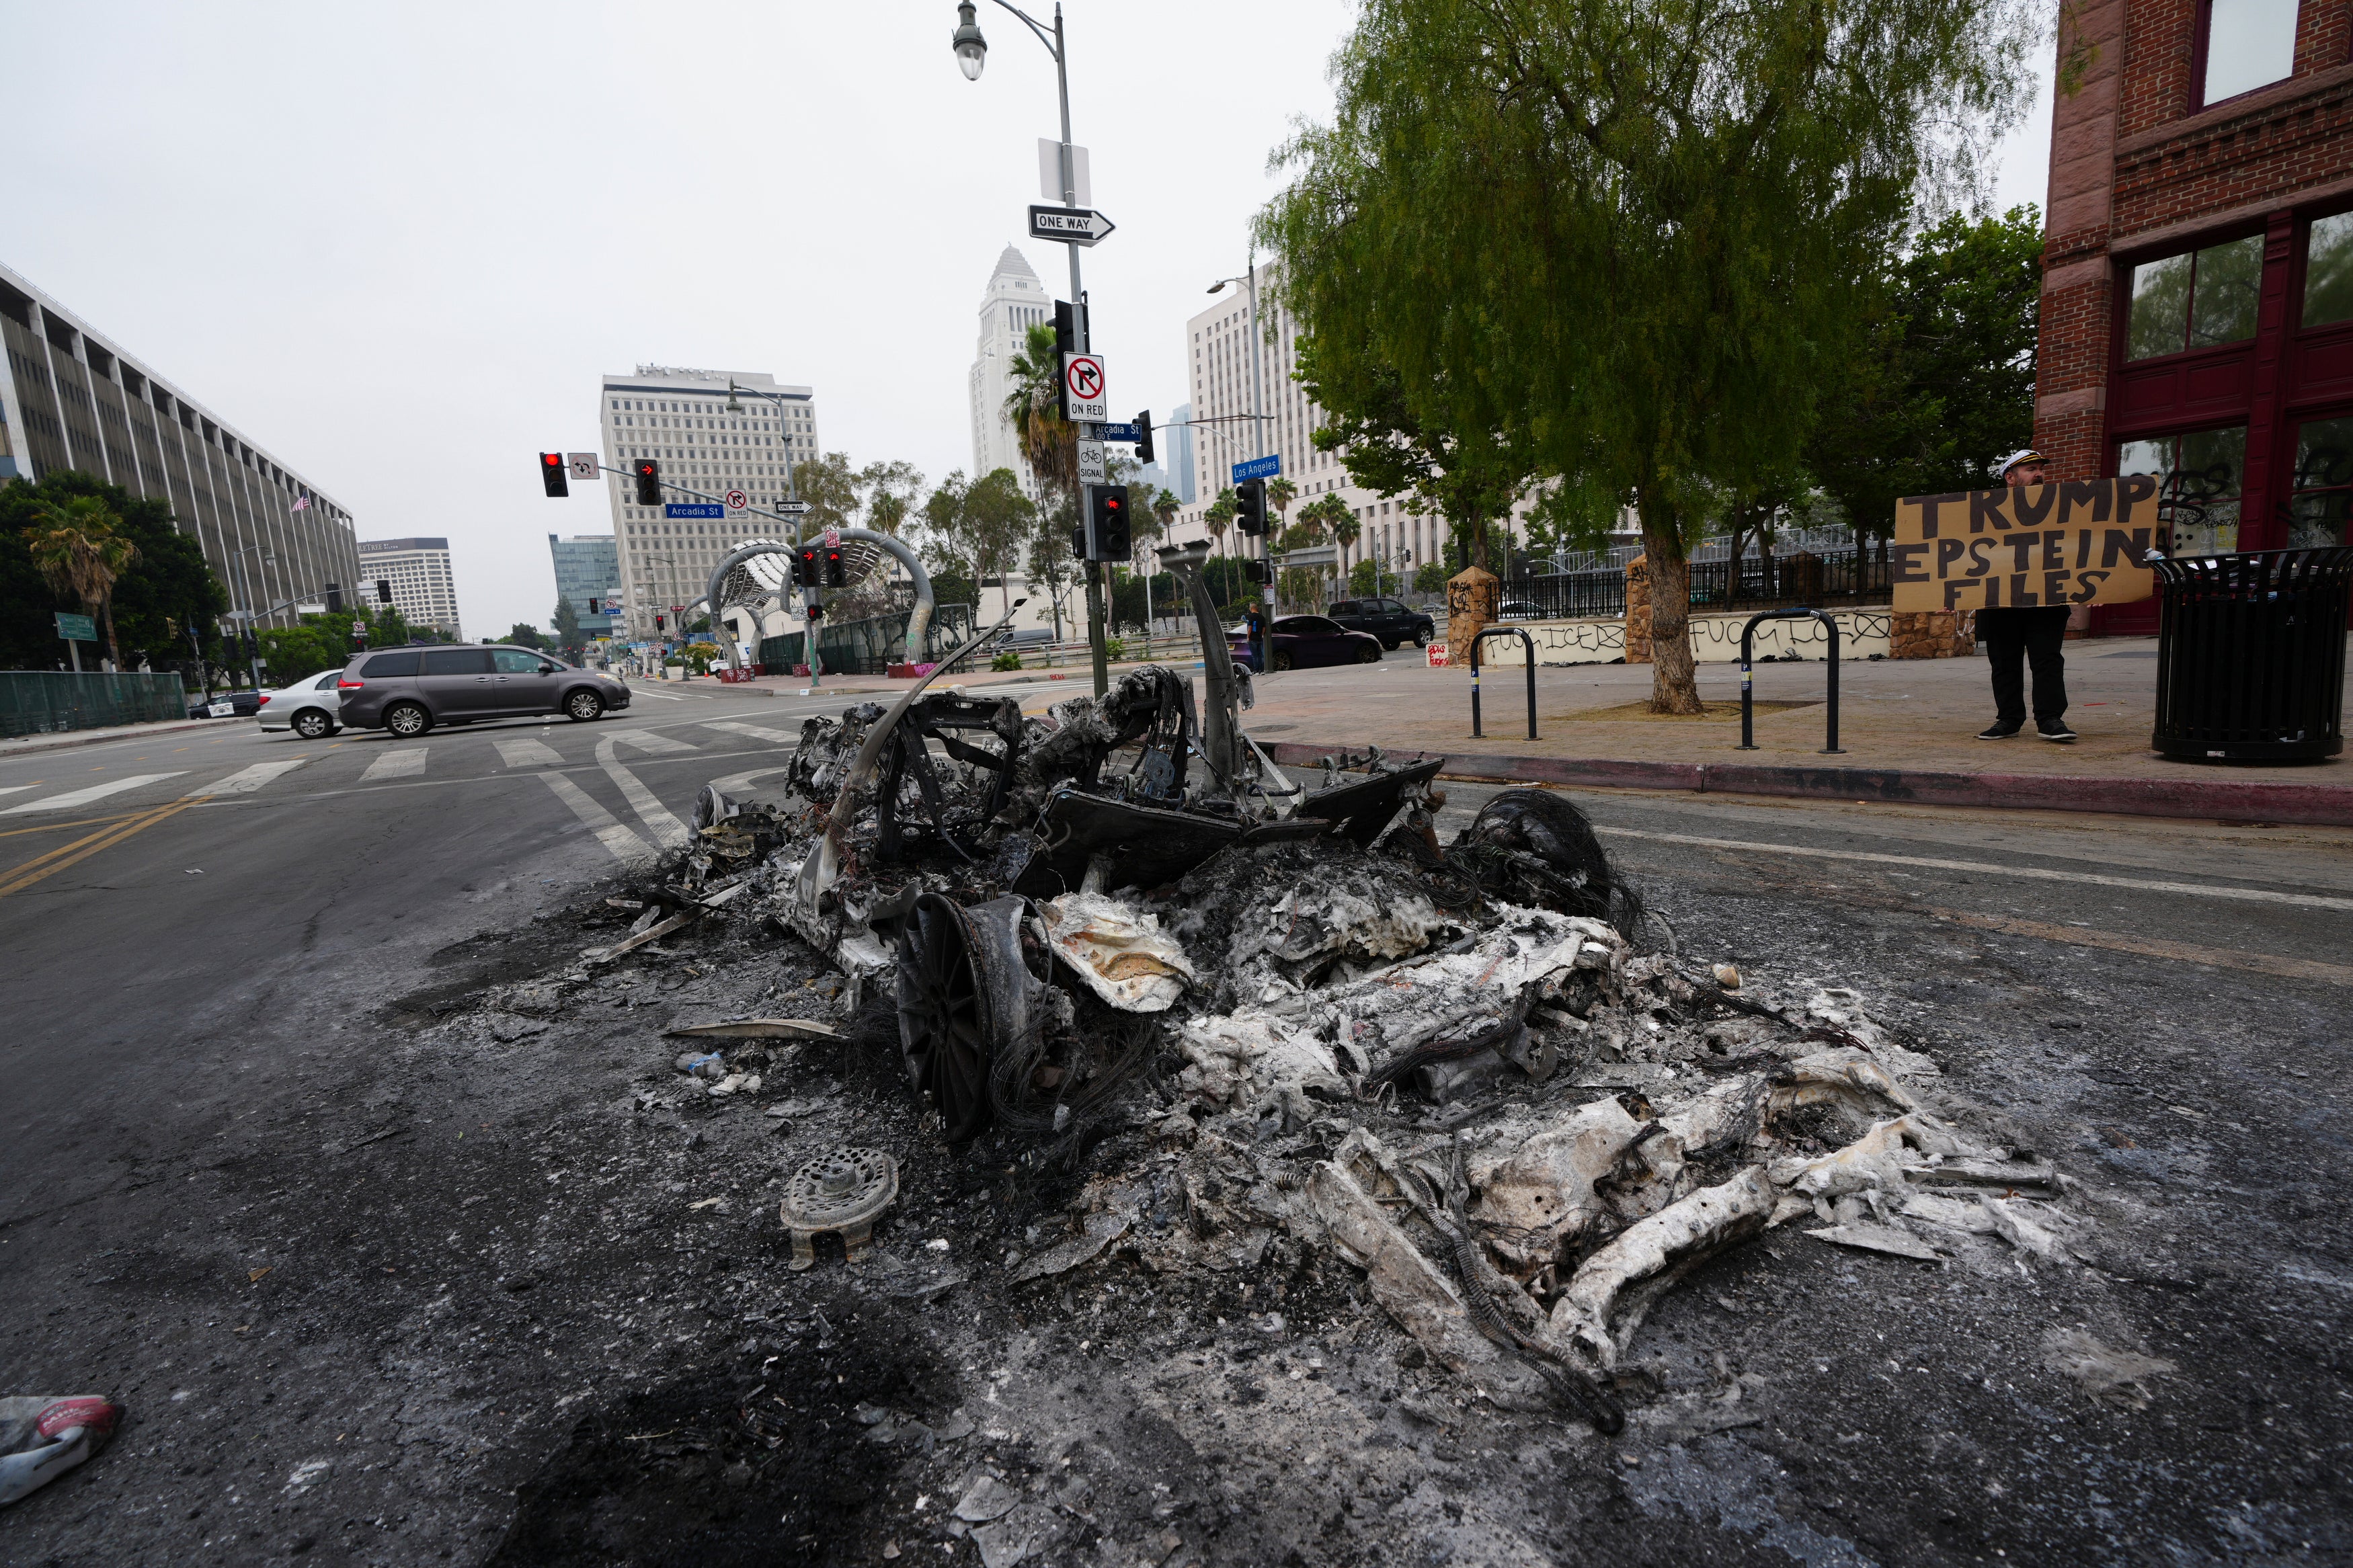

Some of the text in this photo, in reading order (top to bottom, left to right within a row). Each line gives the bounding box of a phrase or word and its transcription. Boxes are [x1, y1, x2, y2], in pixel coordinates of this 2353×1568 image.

[1039, 215, 1090, 230] ONE WAY
[1072, 403, 1103, 416] ON RED
[1095, 424, 1140, 434] Arcadia St
[1080, 468, 1104, 478] SIGNAL
[1234, 460, 1277, 478] Los Angeles
[672, 507, 719, 515] Arcadia St
[1903, 476, 2157, 540] TRUMP
[1894, 528, 2152, 583] EPSTEIN
[1944, 569, 2111, 611] FILES
